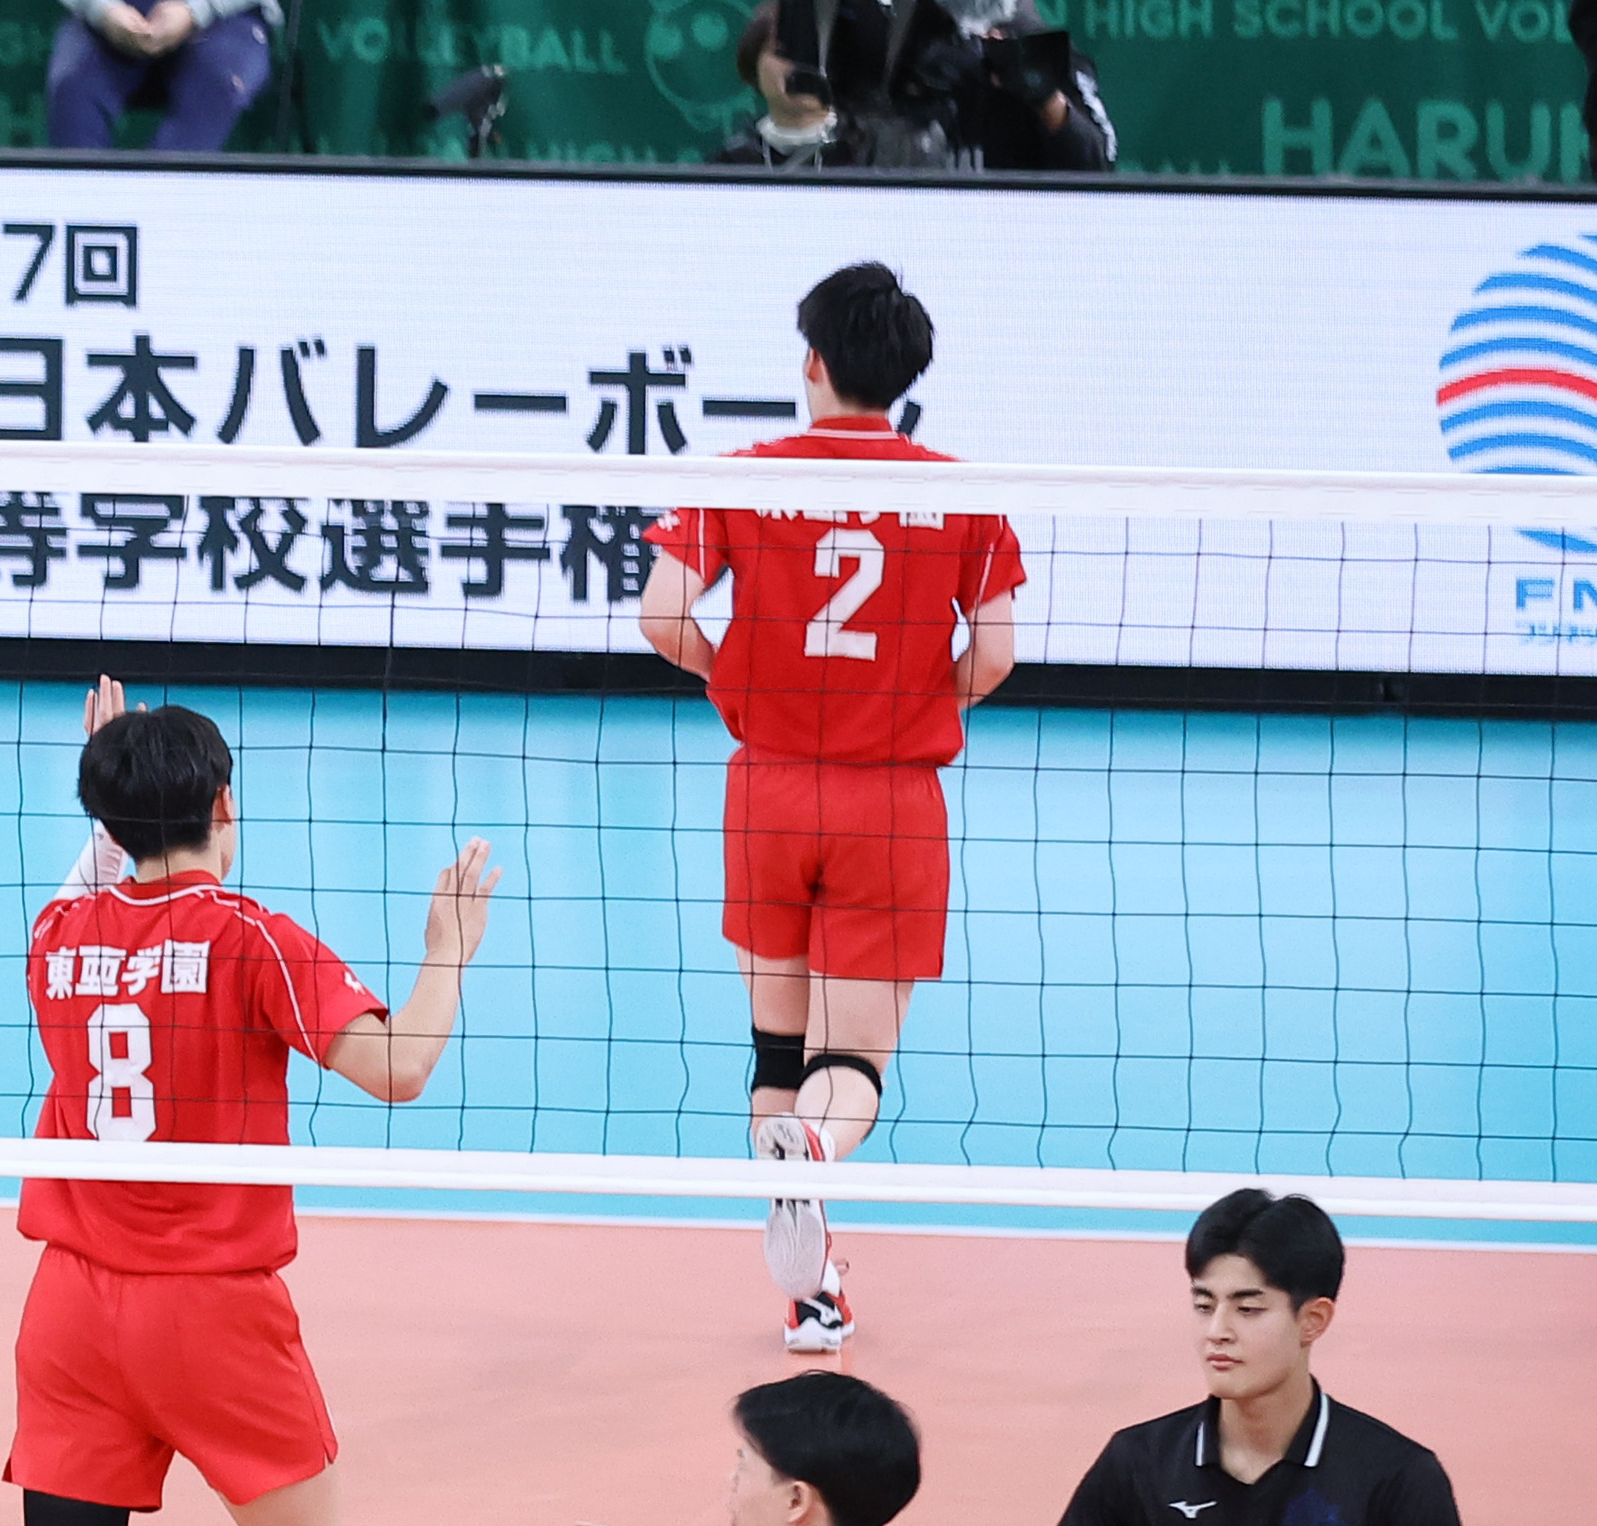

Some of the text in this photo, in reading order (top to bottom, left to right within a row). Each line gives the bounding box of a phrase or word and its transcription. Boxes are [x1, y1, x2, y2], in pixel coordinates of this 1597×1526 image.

[1083, 0, 1213, 39] HIGH
[1233, 0, 1459, 40] SCHOOL
[804, 528, 885, 661] 2
[45, 939, 211, 1000] 東亜学園
[86, 1003, 157, 1141] 8
